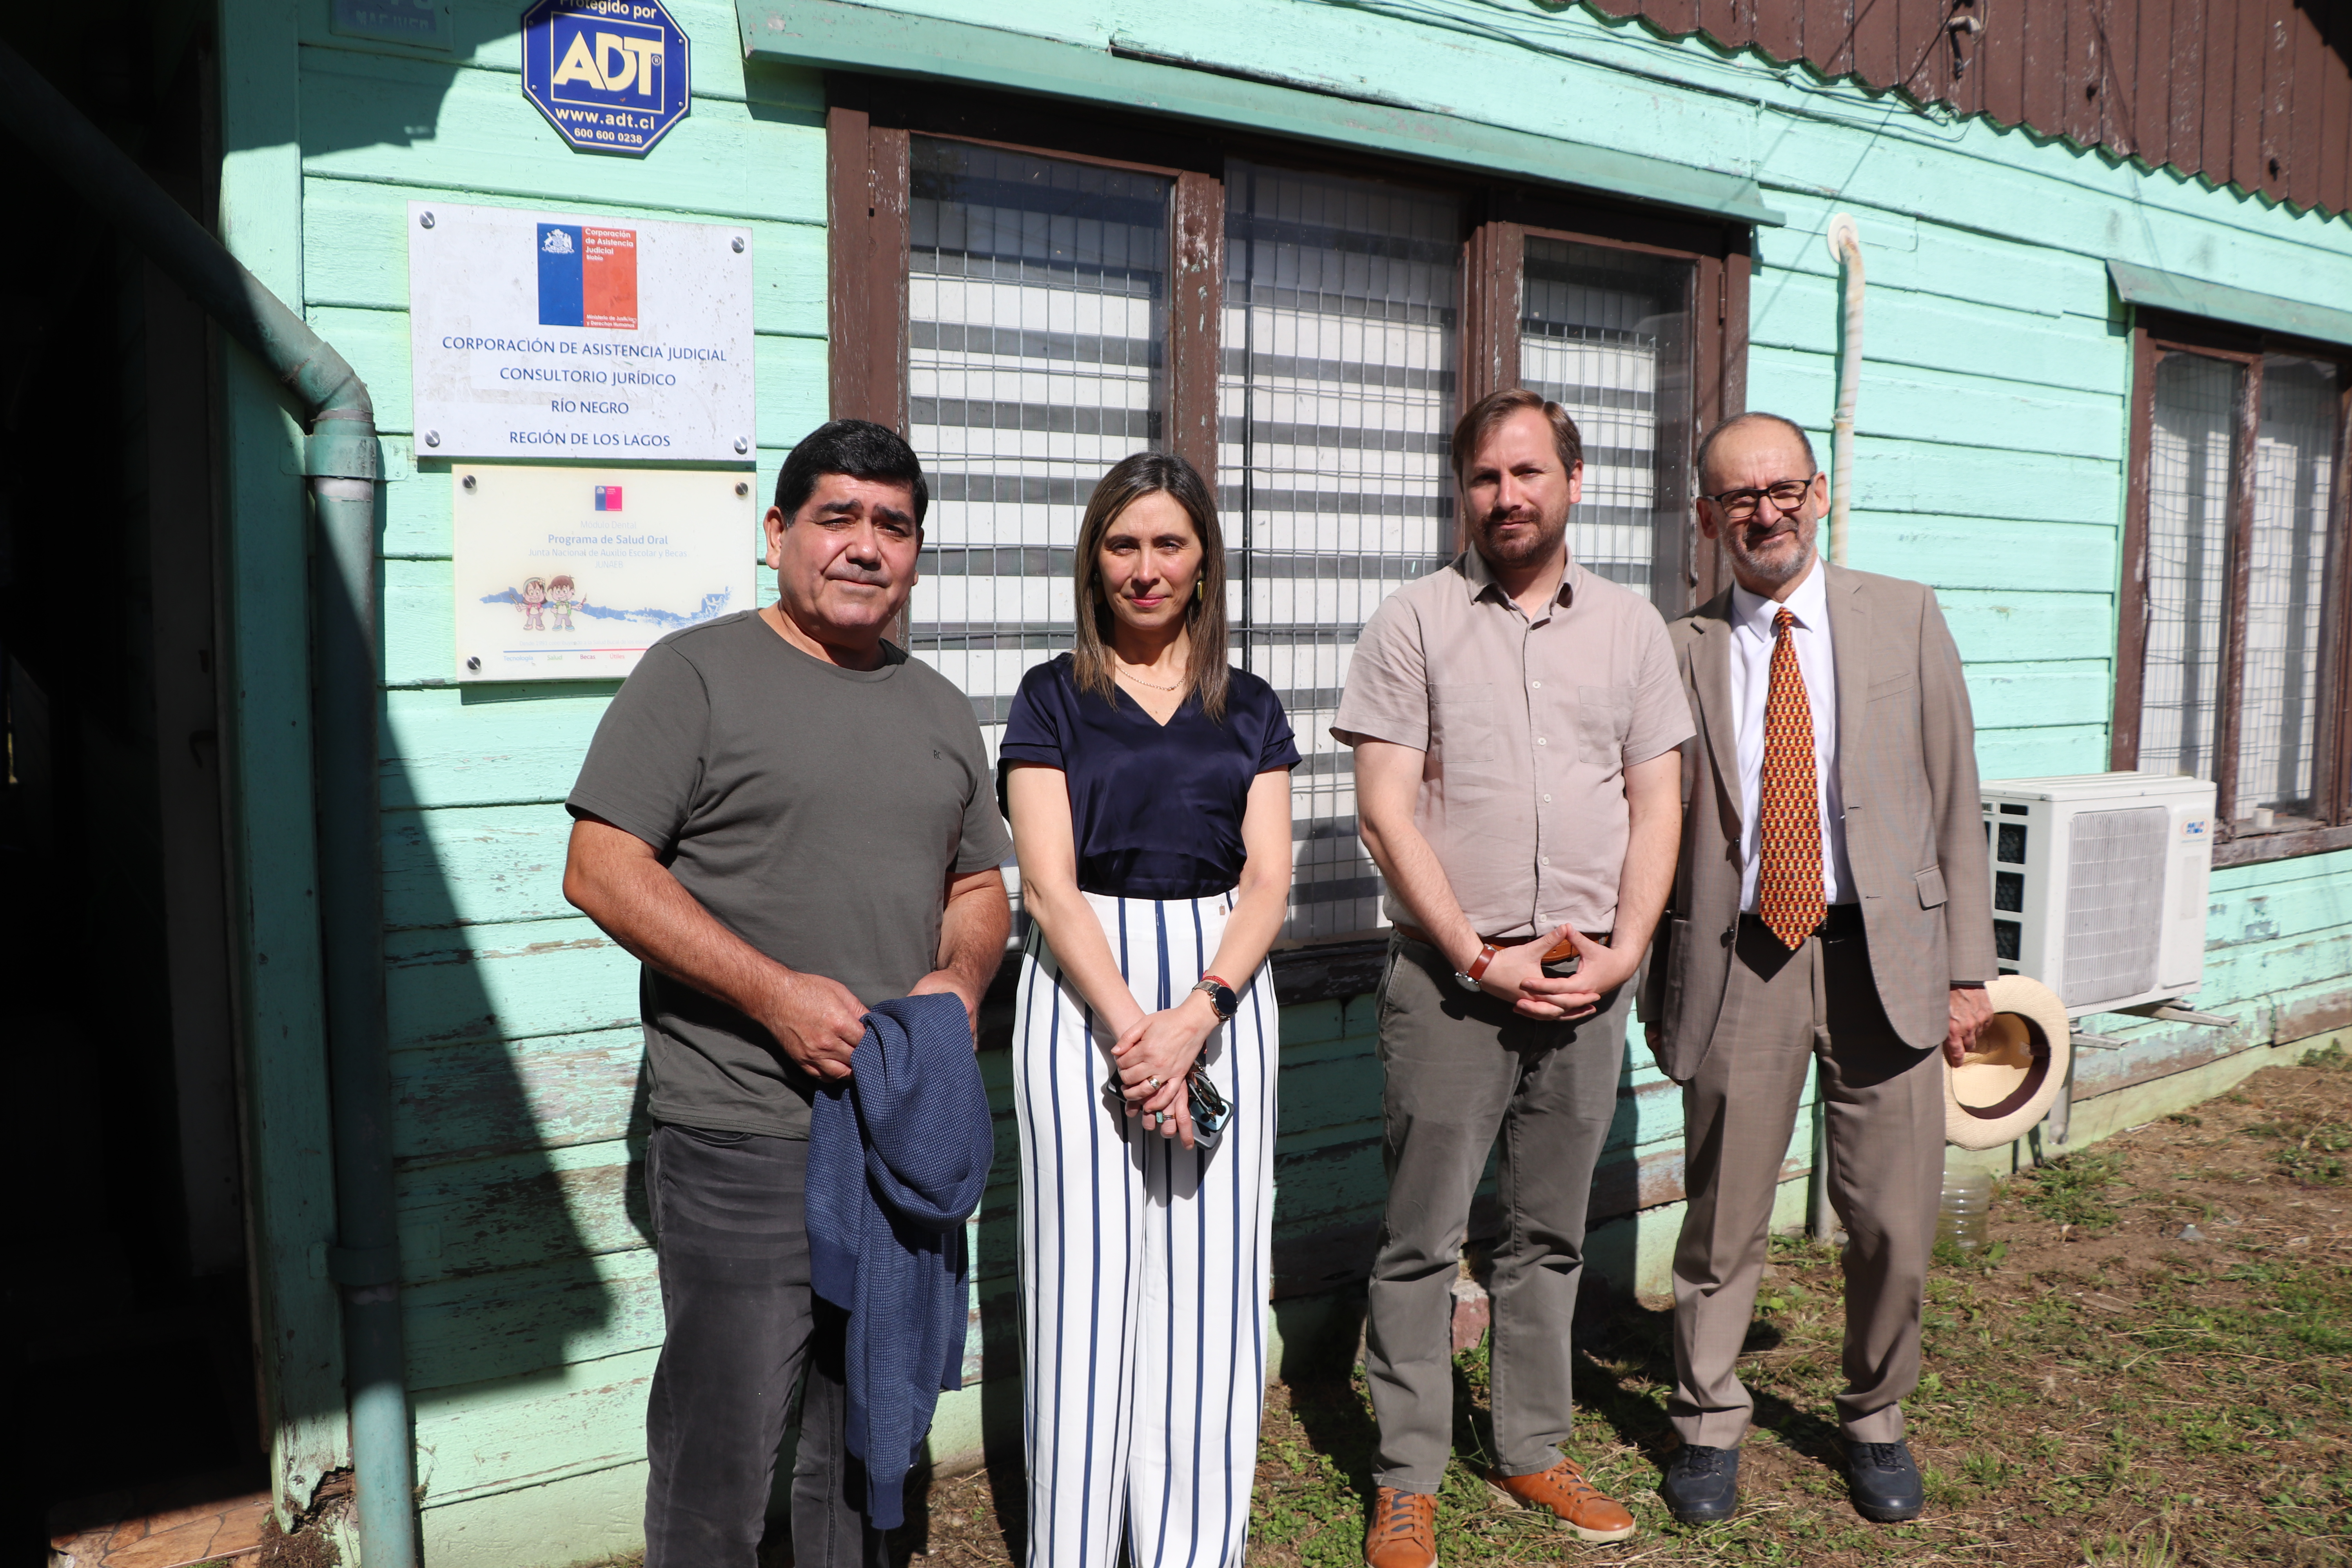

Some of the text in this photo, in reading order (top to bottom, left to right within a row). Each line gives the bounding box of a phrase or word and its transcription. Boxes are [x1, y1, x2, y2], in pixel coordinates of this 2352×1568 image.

[633, 6, 657, 19] por
[553, 30, 662, 95] ADT
[555, 108, 654, 130] www.adt.cl
[574, 128, 642, 143] 600 600 0238
[585, 228, 631, 238] Corporación
[585, 246, 614, 254] Judicial
[597, 238, 634, 247] Asistencia
[443, 336, 726, 361] CORPORACIÓN DE ASISTENCIA JUDICIAL
[500, 367, 676, 386] CONSULTORIO JURÍDICO
[551, 397, 629, 414] RÍO NEGRO
[510, 429, 671, 446] REGIÓN DE LOS LAGOS
[581, 520, 637, 529] Módulo Dental
[548, 534, 668, 546] Programa de Salud Oral
